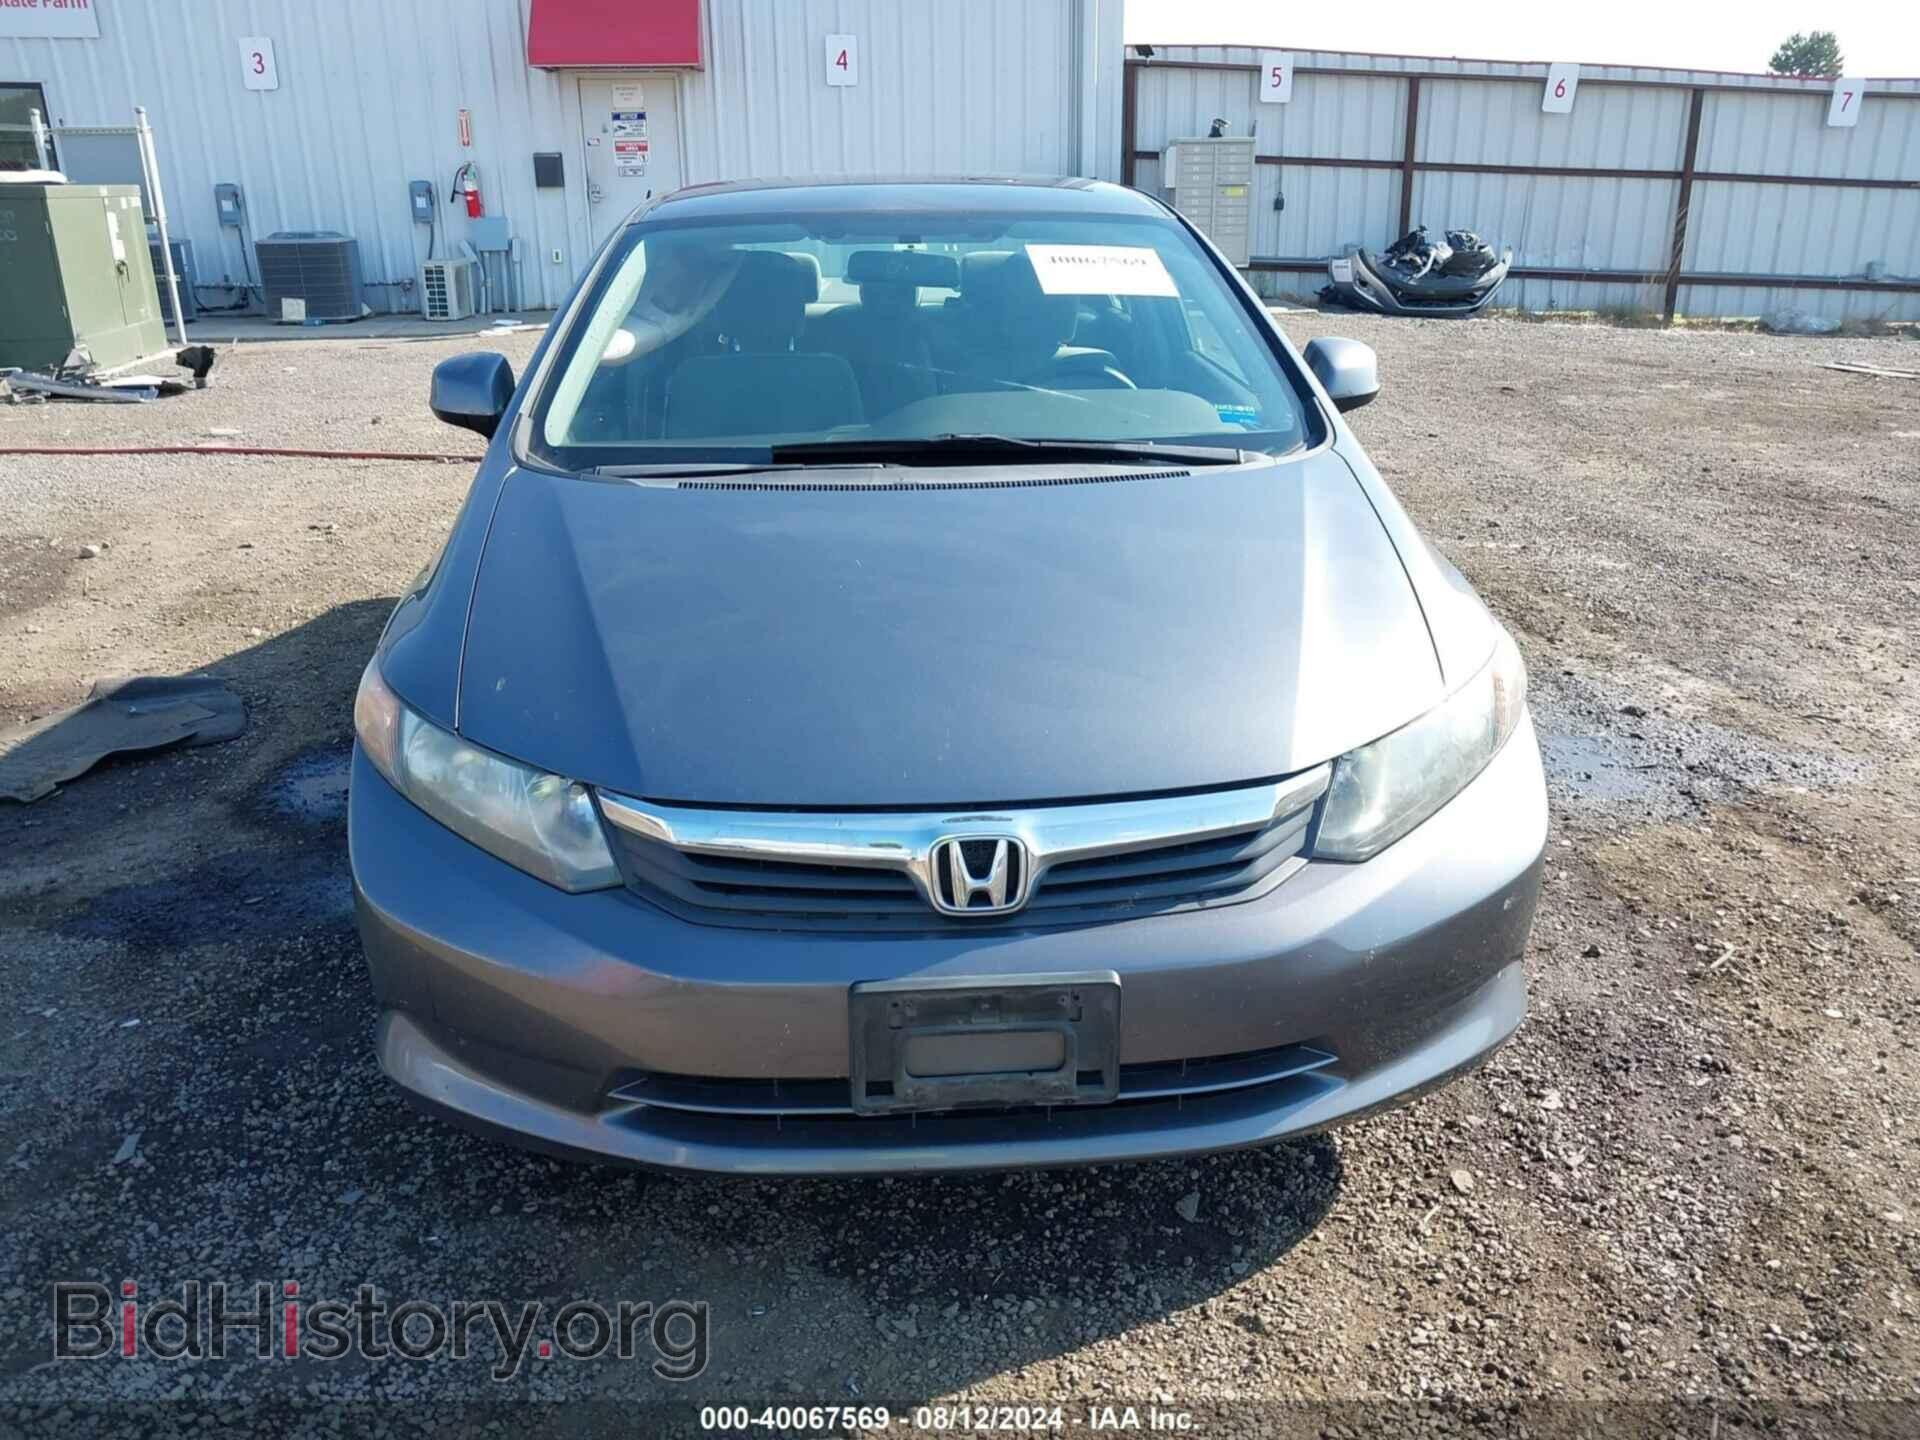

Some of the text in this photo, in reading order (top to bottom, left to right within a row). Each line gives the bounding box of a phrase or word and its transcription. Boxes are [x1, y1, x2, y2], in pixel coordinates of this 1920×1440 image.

[252, 52, 265, 74] 3
[836, 49, 848, 71] 4
[1271, 67, 1282, 87] 5
[1555, 78, 1566, 98] 6
[1841, 92, 1853, 112] 7
